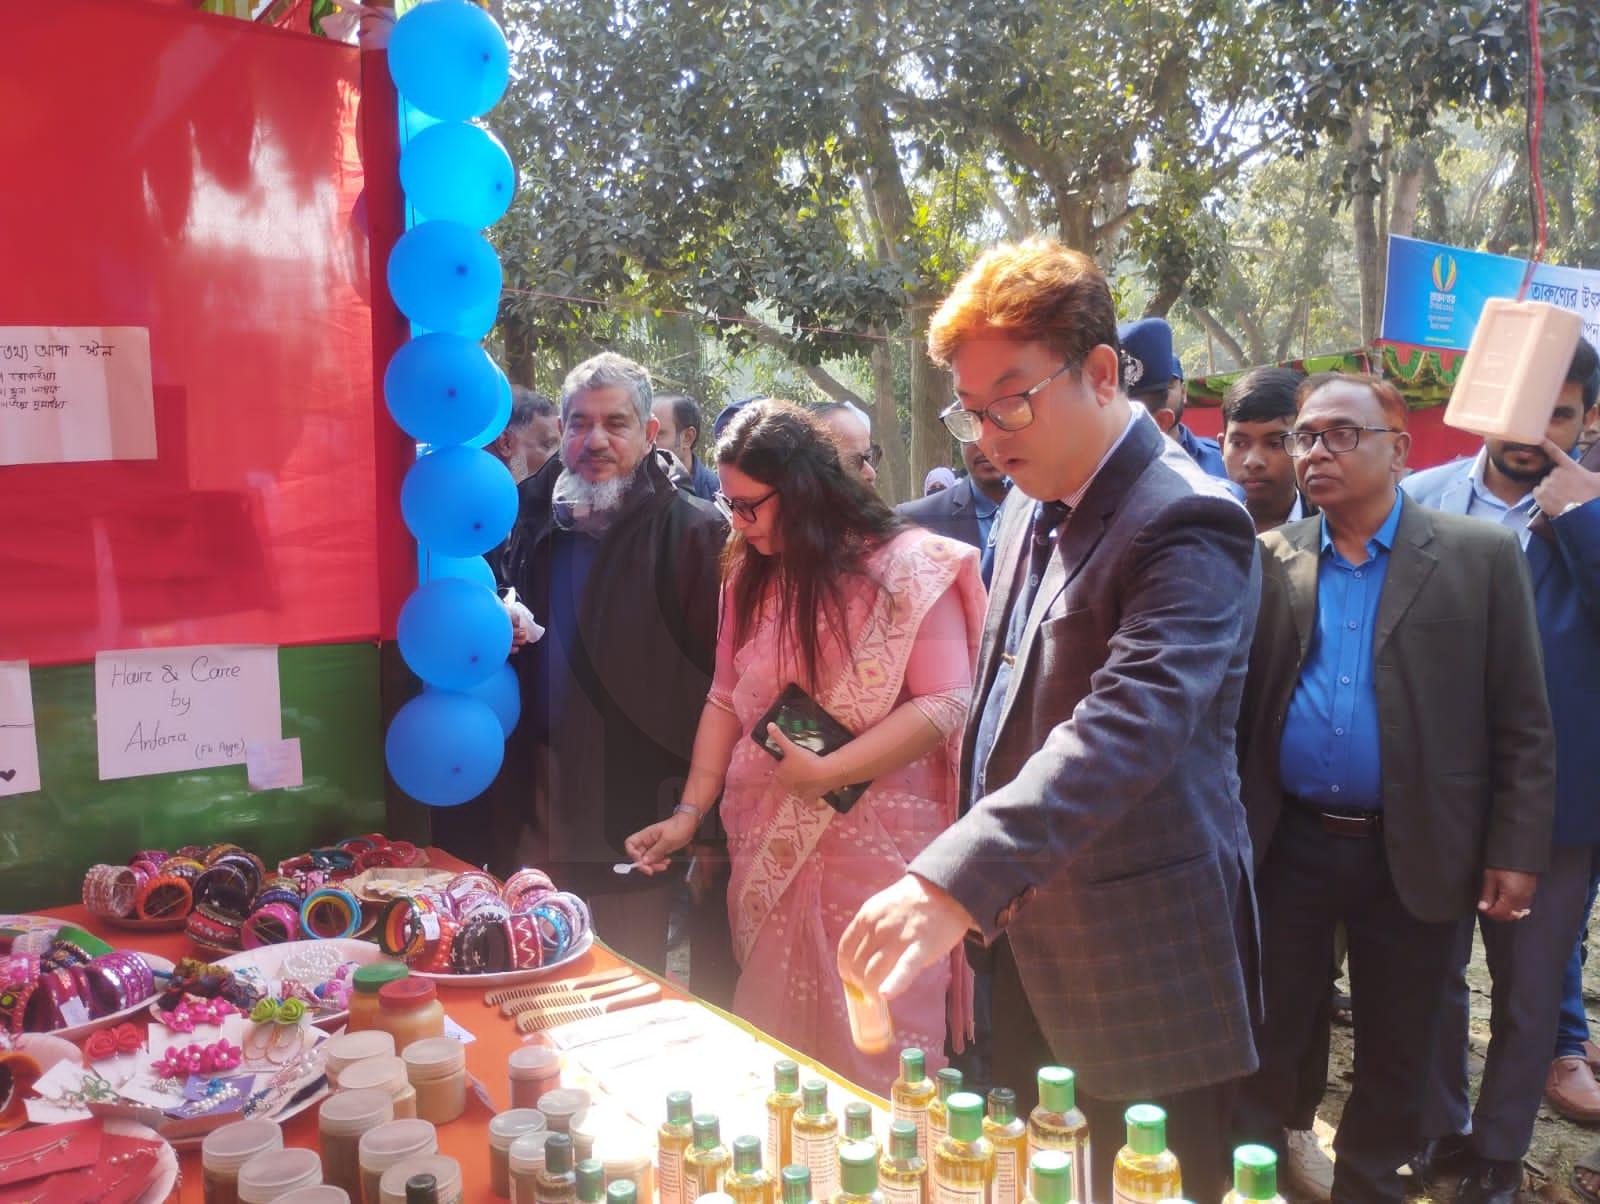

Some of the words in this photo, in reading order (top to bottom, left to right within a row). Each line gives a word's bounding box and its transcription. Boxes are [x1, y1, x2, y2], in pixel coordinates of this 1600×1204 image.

[161, 664, 179, 683] &
[190, 655, 242, 682] Care
[170, 688, 192, 717] by
